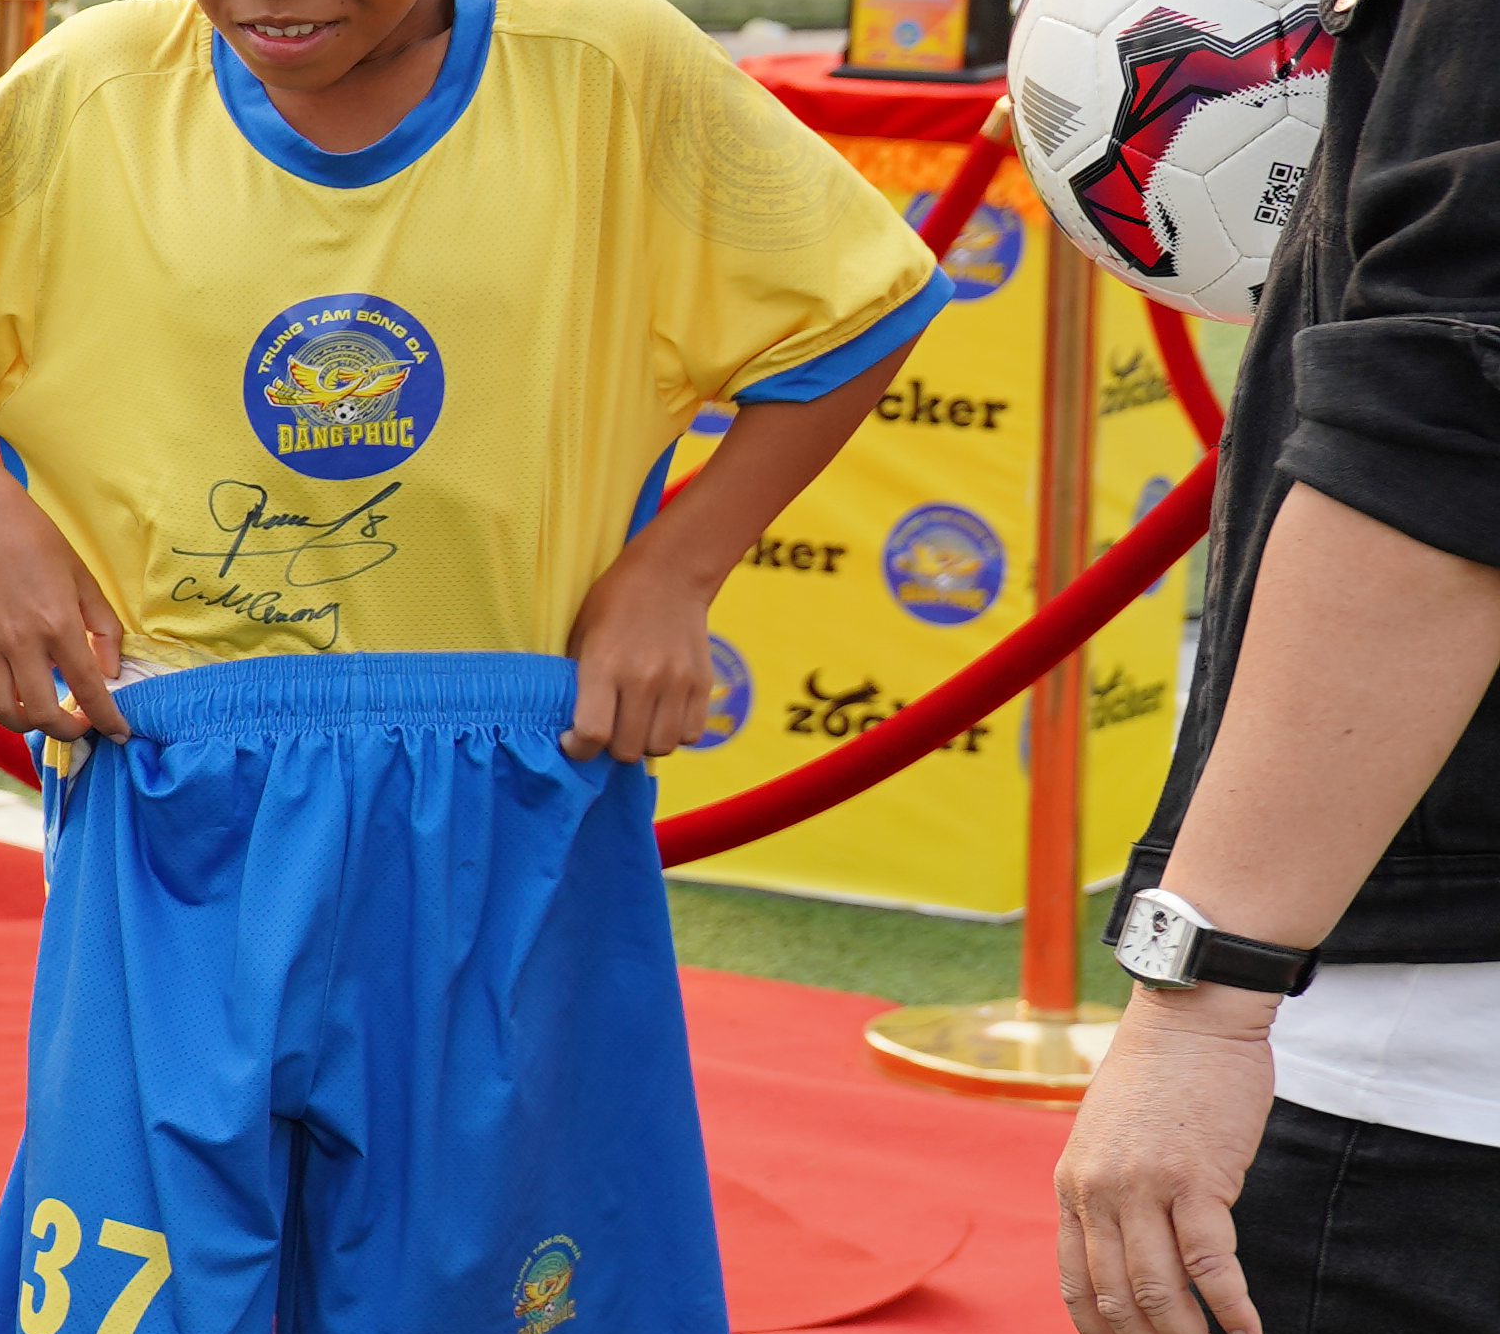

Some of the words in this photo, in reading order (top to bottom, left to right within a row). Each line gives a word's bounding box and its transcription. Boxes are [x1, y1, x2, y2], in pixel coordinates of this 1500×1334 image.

[257, 321, 304, 375] TRUNG
[306, 307, 351, 327] TÂM
[355, 309, 408, 340] BÓNG
[405, 337, 430, 366] ĐÁ
[277, 416, 344, 455] ĐĂNG
[348, 409, 416, 449] PHÚC
